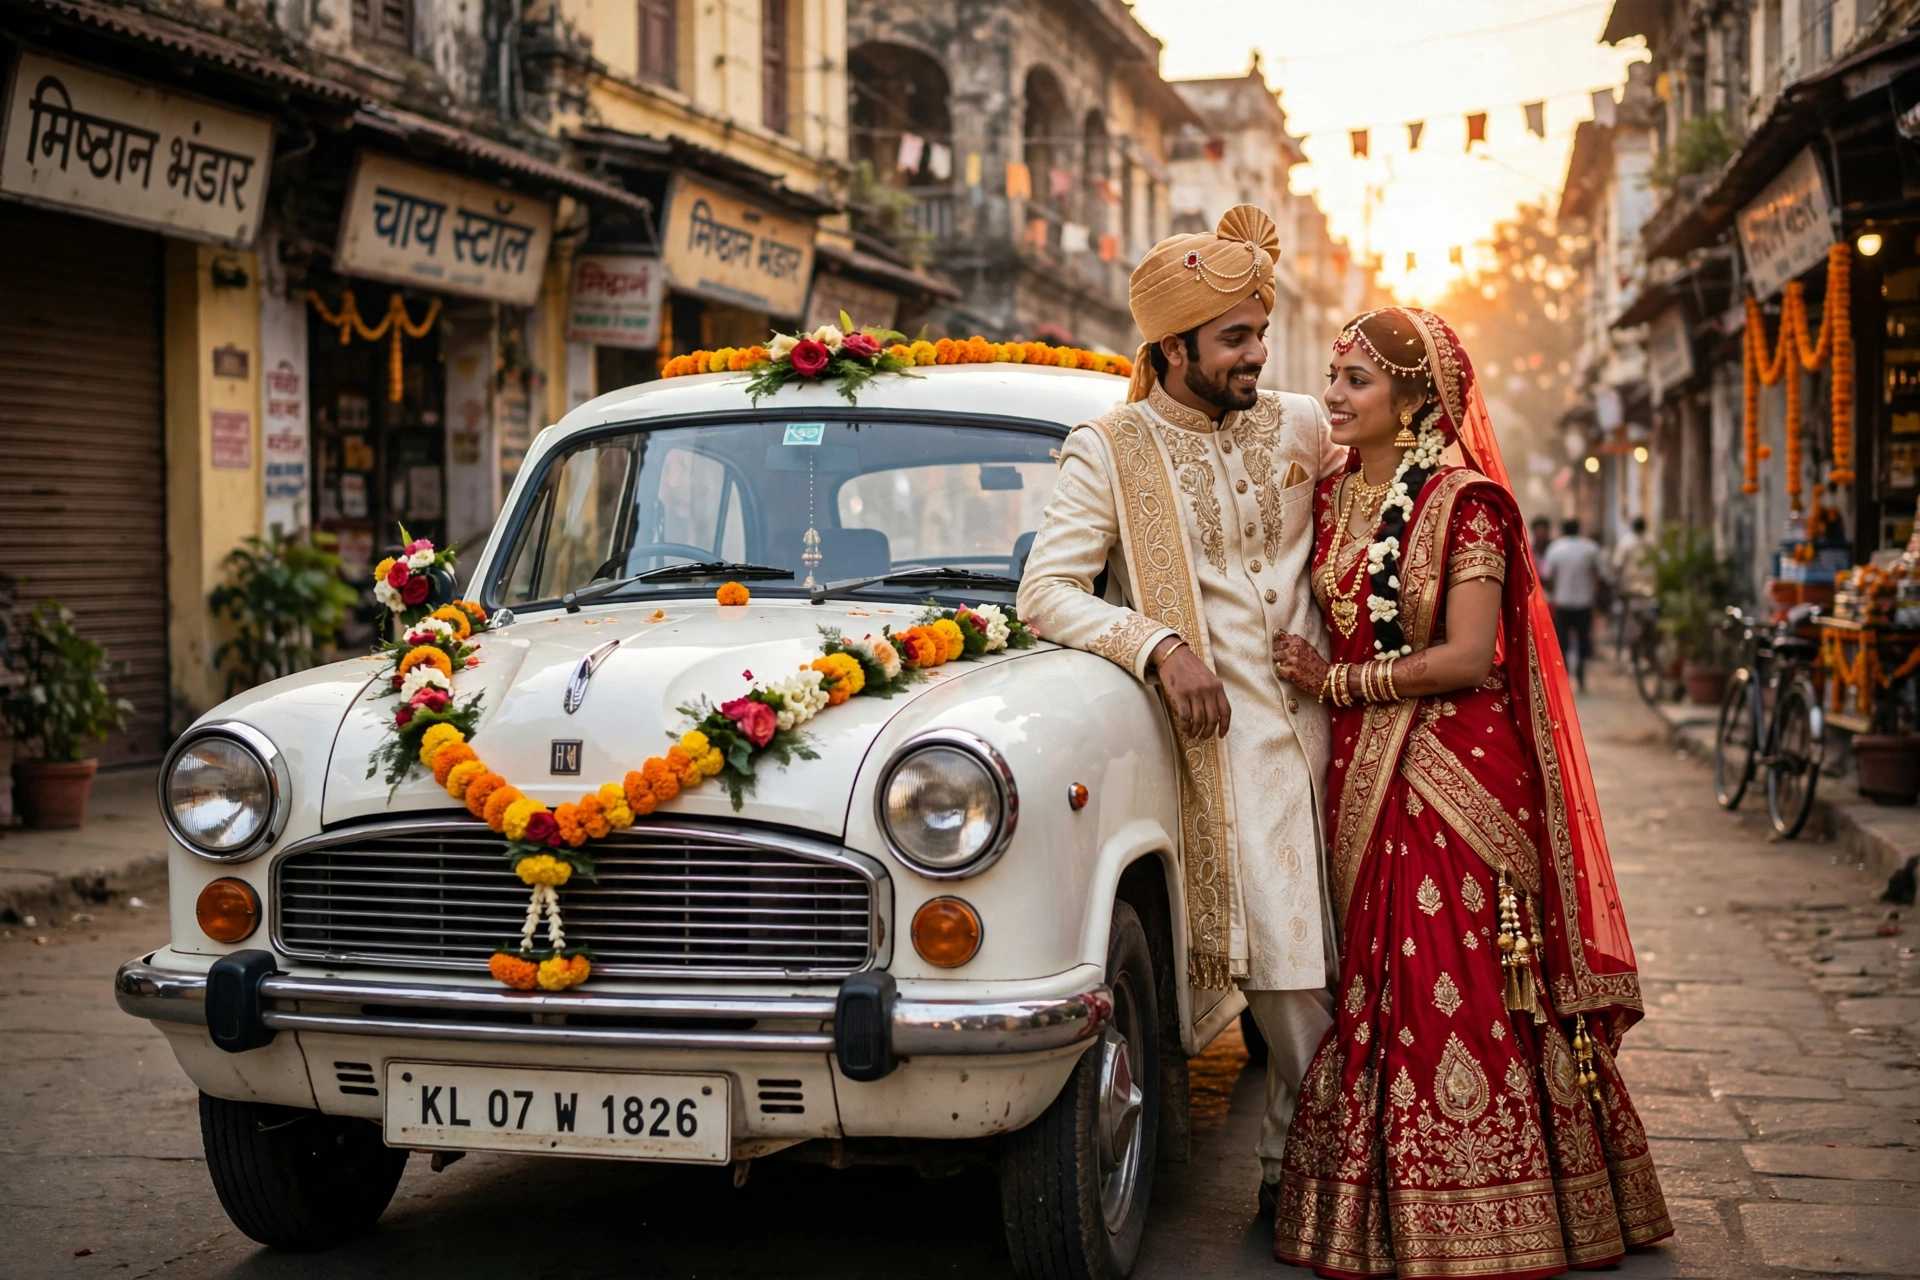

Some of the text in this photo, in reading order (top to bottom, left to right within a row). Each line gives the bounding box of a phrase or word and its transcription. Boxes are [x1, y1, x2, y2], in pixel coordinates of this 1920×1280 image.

[26, 75, 255, 214] मिष्ठान भंडार
[373, 185, 536, 274] चाय स्टॉल
[421, 1085, 698, 1138] KL 07 W 1826
